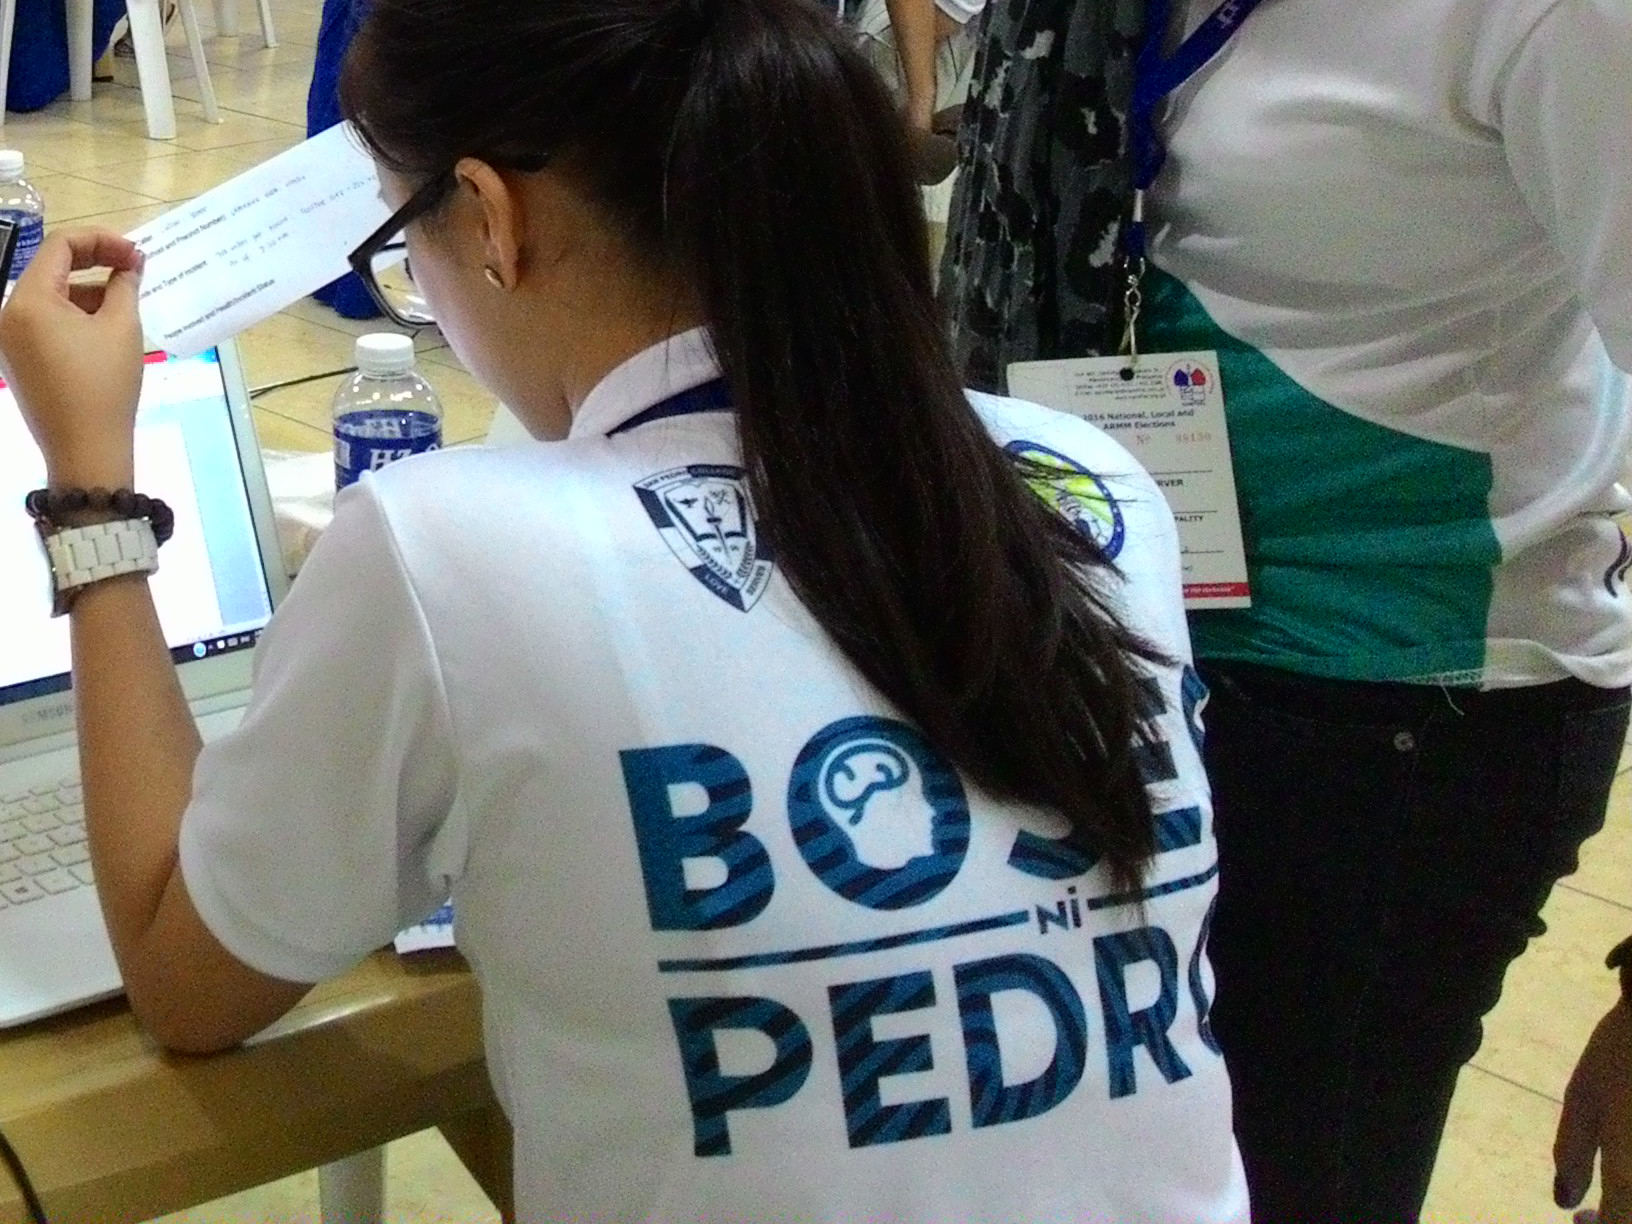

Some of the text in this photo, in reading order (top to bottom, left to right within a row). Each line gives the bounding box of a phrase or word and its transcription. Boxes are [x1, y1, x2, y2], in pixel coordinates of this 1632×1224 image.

[1107, 411, 1148, 421] National,
[1151, 410, 1175, 419] Local
[1176, 408, 1195, 417] and
[1103, 419, 1176, 430] ARMM Elections
[668, 898, 1221, 1158] PEDR
